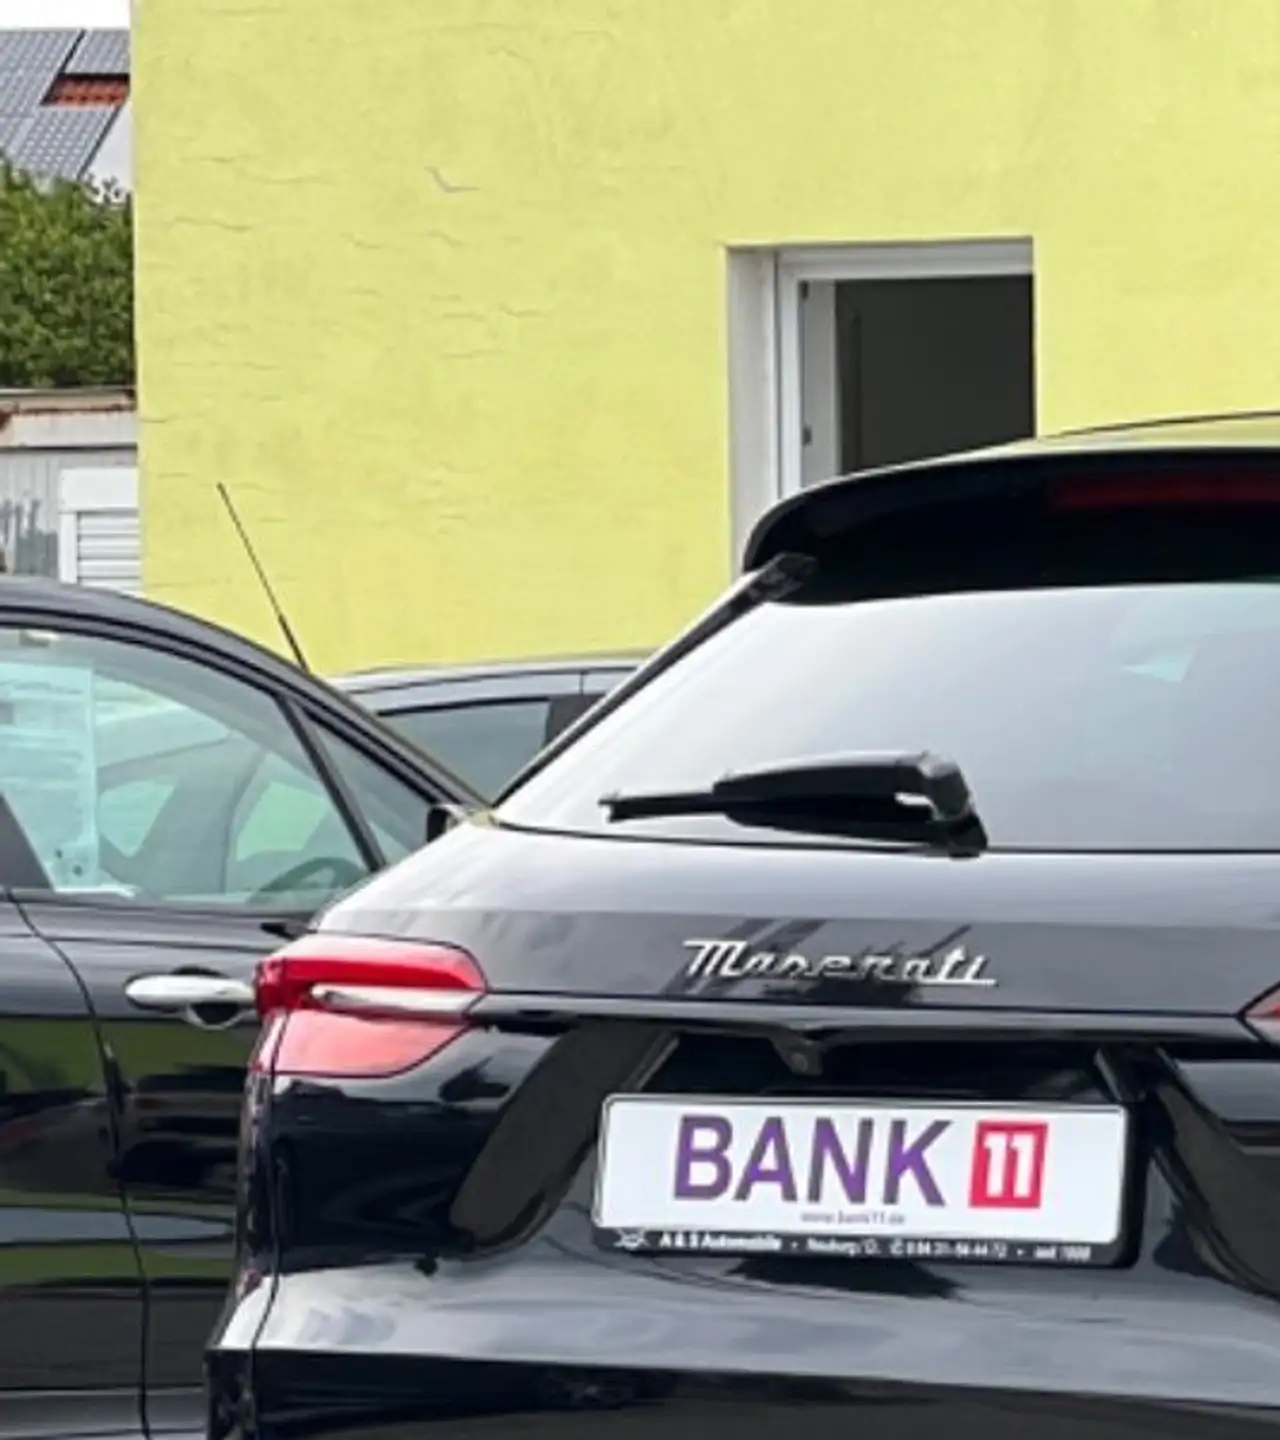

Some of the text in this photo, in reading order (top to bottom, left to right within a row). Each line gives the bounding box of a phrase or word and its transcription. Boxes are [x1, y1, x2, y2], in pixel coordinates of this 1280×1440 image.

[682, 939, 999, 987] Maserati
[673, 1113, 1040, 1207] BANK 11
[701, 1230, 783, 1251] Automobile
